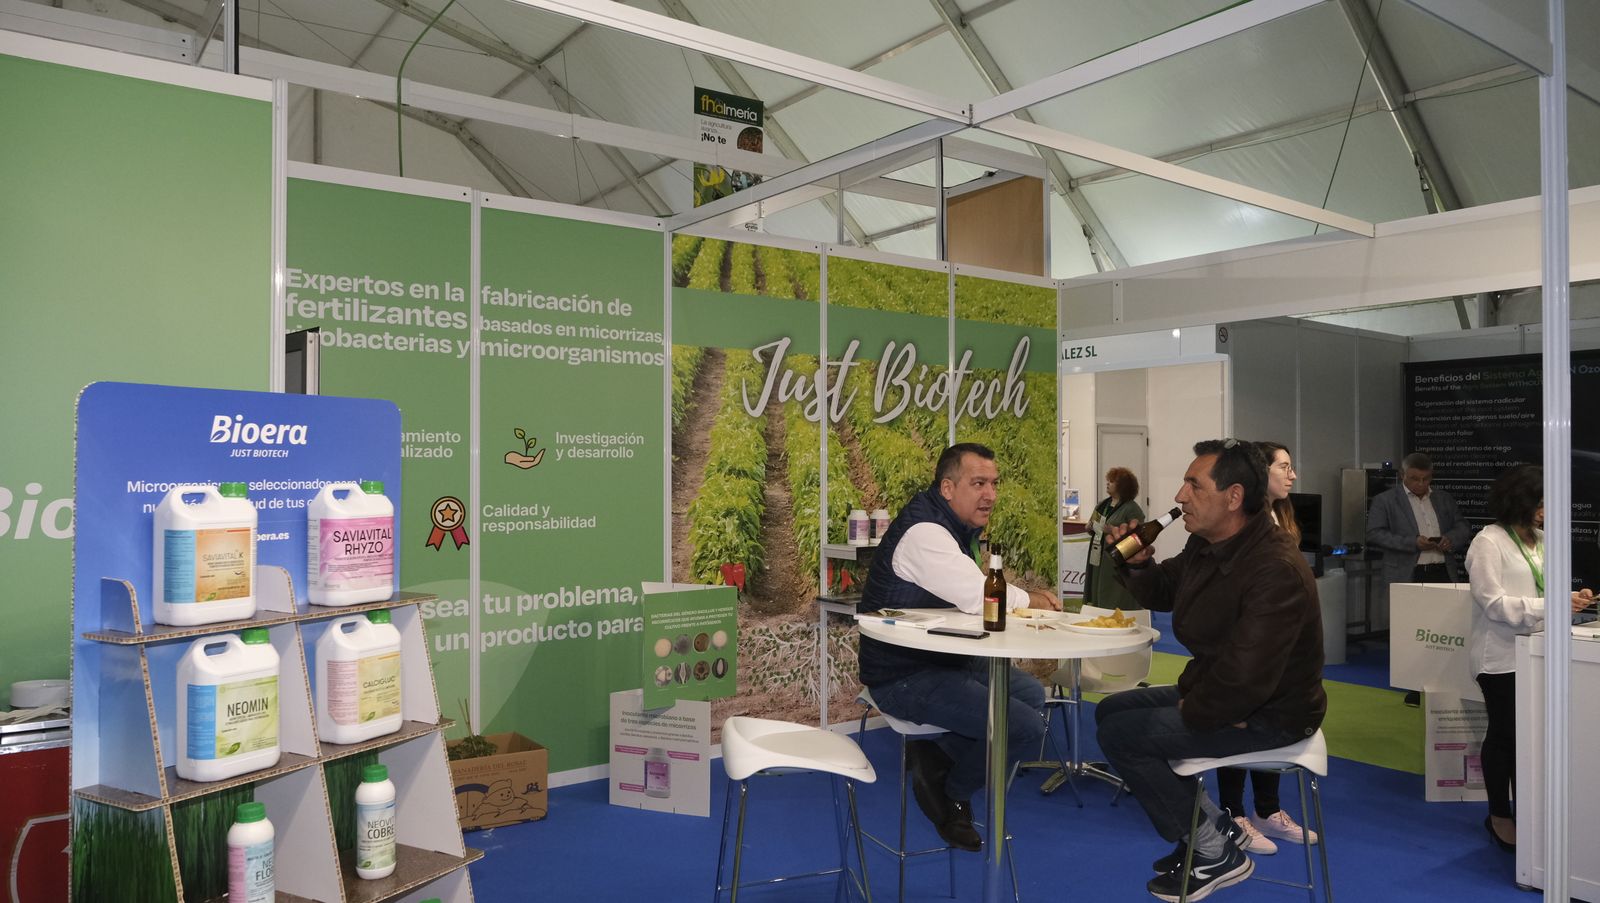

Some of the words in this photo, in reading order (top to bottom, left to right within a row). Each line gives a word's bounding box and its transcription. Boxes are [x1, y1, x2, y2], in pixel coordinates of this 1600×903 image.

[718, 136, 727, 145] te
[285, 267, 405, 297] Expertos
[409, 283, 440, 300] en
[445, 281, 465, 302] la
[481, 285, 604, 314] fabricación
[607, 298, 632, 316] de
[286, 292, 468, 330] fertilizantes
[480, 315, 552, 335] basados
[556, 324, 576, 337] en
[285, 325, 452, 354] obacterias
[456, 339, 471, 359] y
[480, 338, 664, 366] microorganismos
[1062, 347, 1083, 360] LEZ
[1085, 345, 1098, 358] SL
[741, 336, 861, 423] Just
[872, 335, 1031, 424] Biotech
[1414, 374, 1464, 384] Beneficios
[1465, 371, 1481, 381] del
[1455, 398, 1465, 406] del
[210, 414, 308, 445] Bioera
[555, 431, 645, 447] Investigación
[230, 449, 252, 458] JUST
[253, 450, 289, 459] BIOTECH
[555, 448, 564, 461] y
[567, 446, 634, 459] desarrollo
[248, 479, 331, 490] seleccionados
[268, 498, 284, 509] de
[286, 498, 305, 508] tus
[482, 503, 538, 519] Calidad
[541, 505, 551, 518] y
[482, 515, 597, 534] responsabilidad
[333, 527, 392, 543] SAVIAVITAL
[345, 541, 384, 555] RHYZO
[421, 599, 469, 619] sea
[482, 593, 511, 615] tu
[517, 585, 639, 617] problema,
[435, 632, 470, 652] un
[480, 619, 593, 653] producto
[597, 616, 644, 640] para
[1415, 628, 1465, 647] Bioera
[227, 697, 269, 718] NEOMIN
